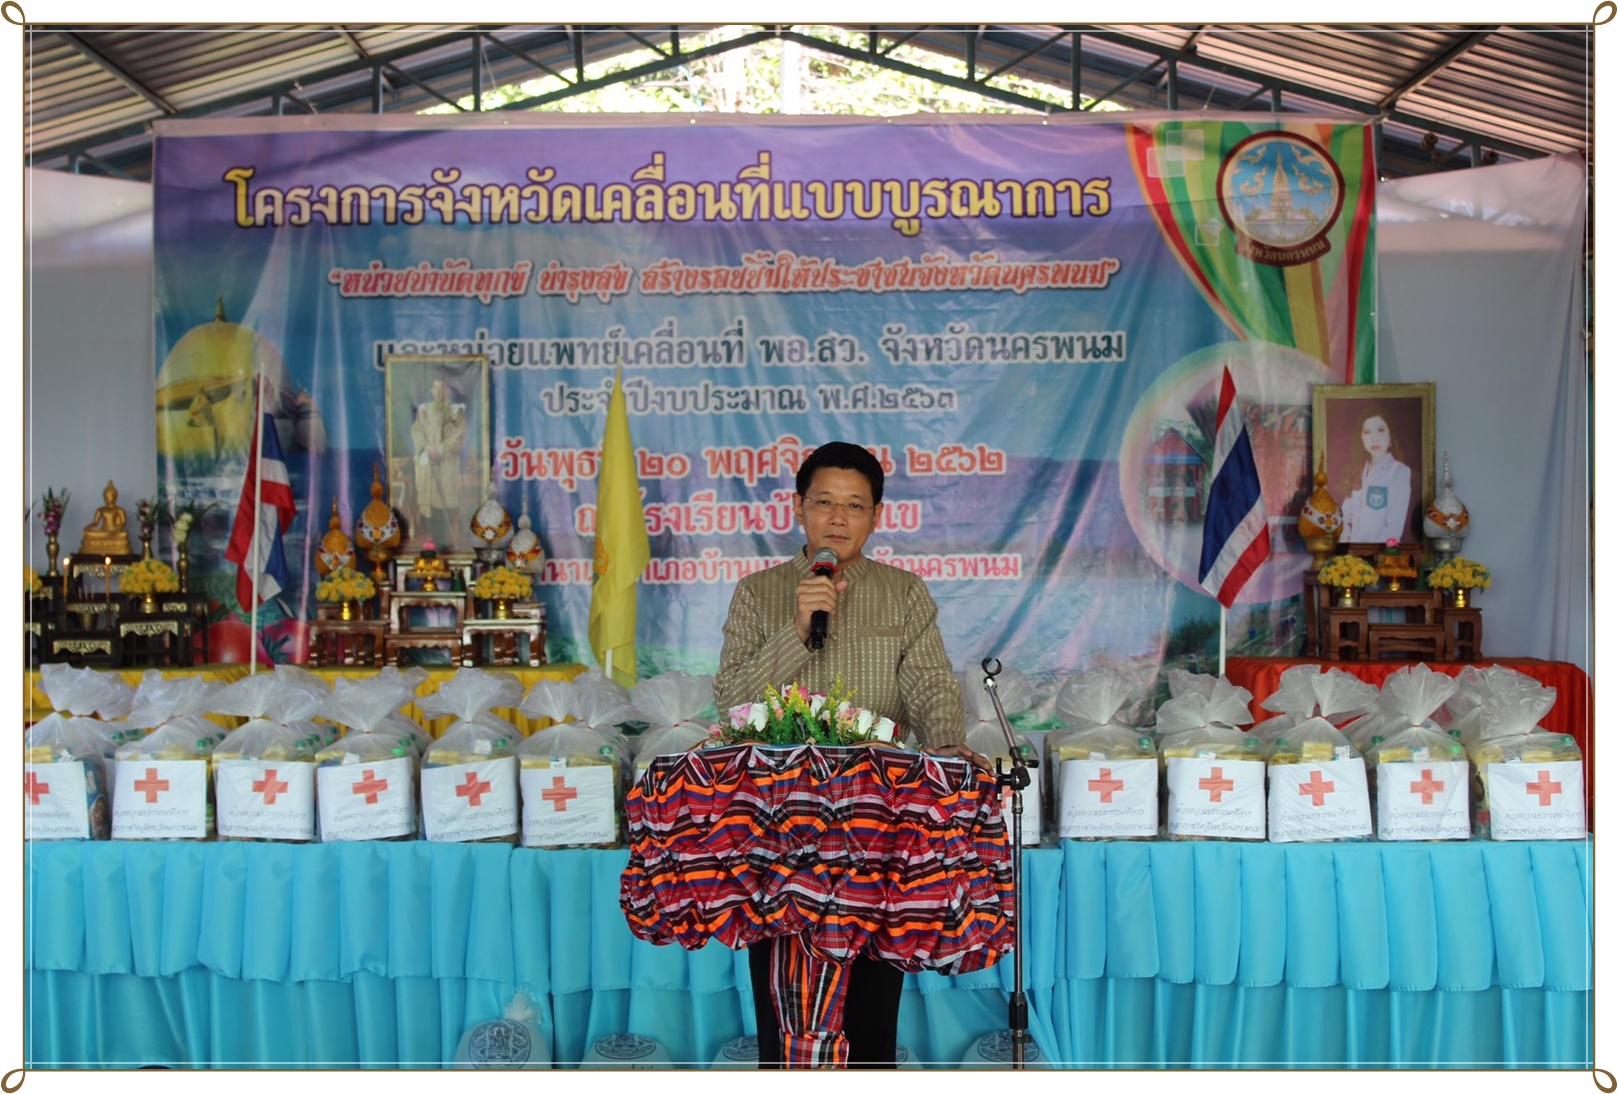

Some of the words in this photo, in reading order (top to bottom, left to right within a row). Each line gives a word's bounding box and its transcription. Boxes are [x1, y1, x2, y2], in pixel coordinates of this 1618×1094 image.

[224, 152, 1111, 236] โครงการจังหวัดเคลื่อนที่แบบบูรณาการ
[538, 262, 632, 302] บำรุงสุข
[760, 334, 866, 364] พอ.สว.
[881, 325, 1124, 362] จังหวัดนครพนม
[819, 383, 955, 411] พ.ศ.๒๕๖๓
[501, 439, 603, 489] วันพุธ
[636, 449, 688, 477] ๒๐
[704, 436, 894, 485] พฤศจิน
[906, 445, 1005, 474] ๒๕๖๒
